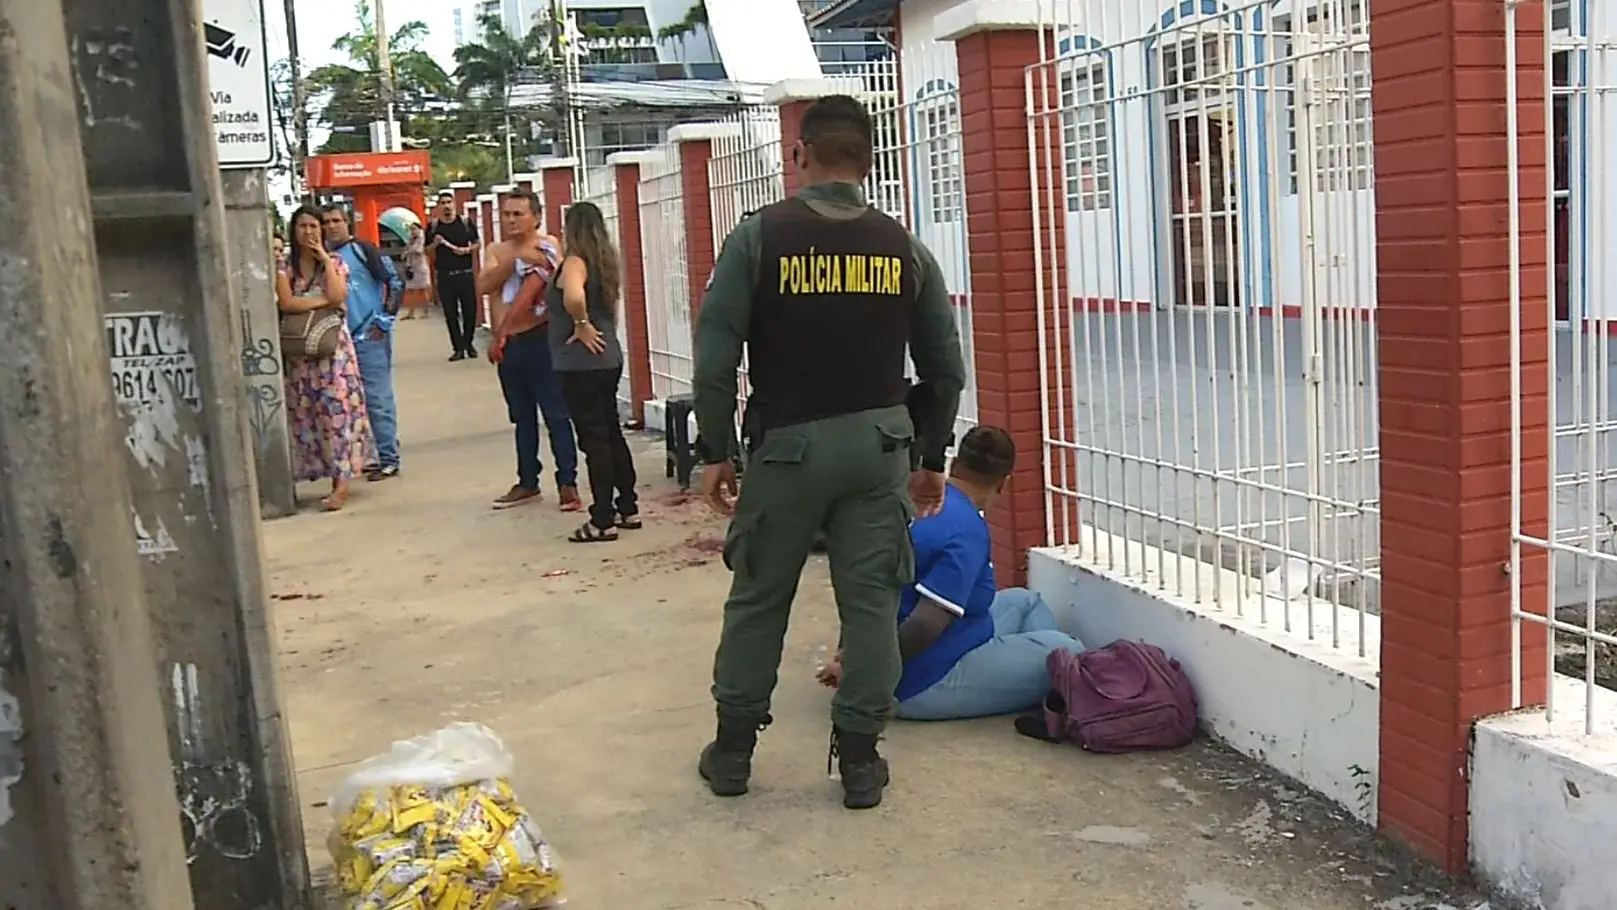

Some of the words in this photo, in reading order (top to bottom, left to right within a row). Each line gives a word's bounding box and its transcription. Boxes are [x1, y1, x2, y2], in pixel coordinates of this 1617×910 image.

[210, 91, 232, 104] Via
[212, 111, 258, 123] alizada
[214, 130, 266, 143] âmeras
[779, 246, 841, 294] POLÍCIA
[845, 255, 902, 294] MILITAR
